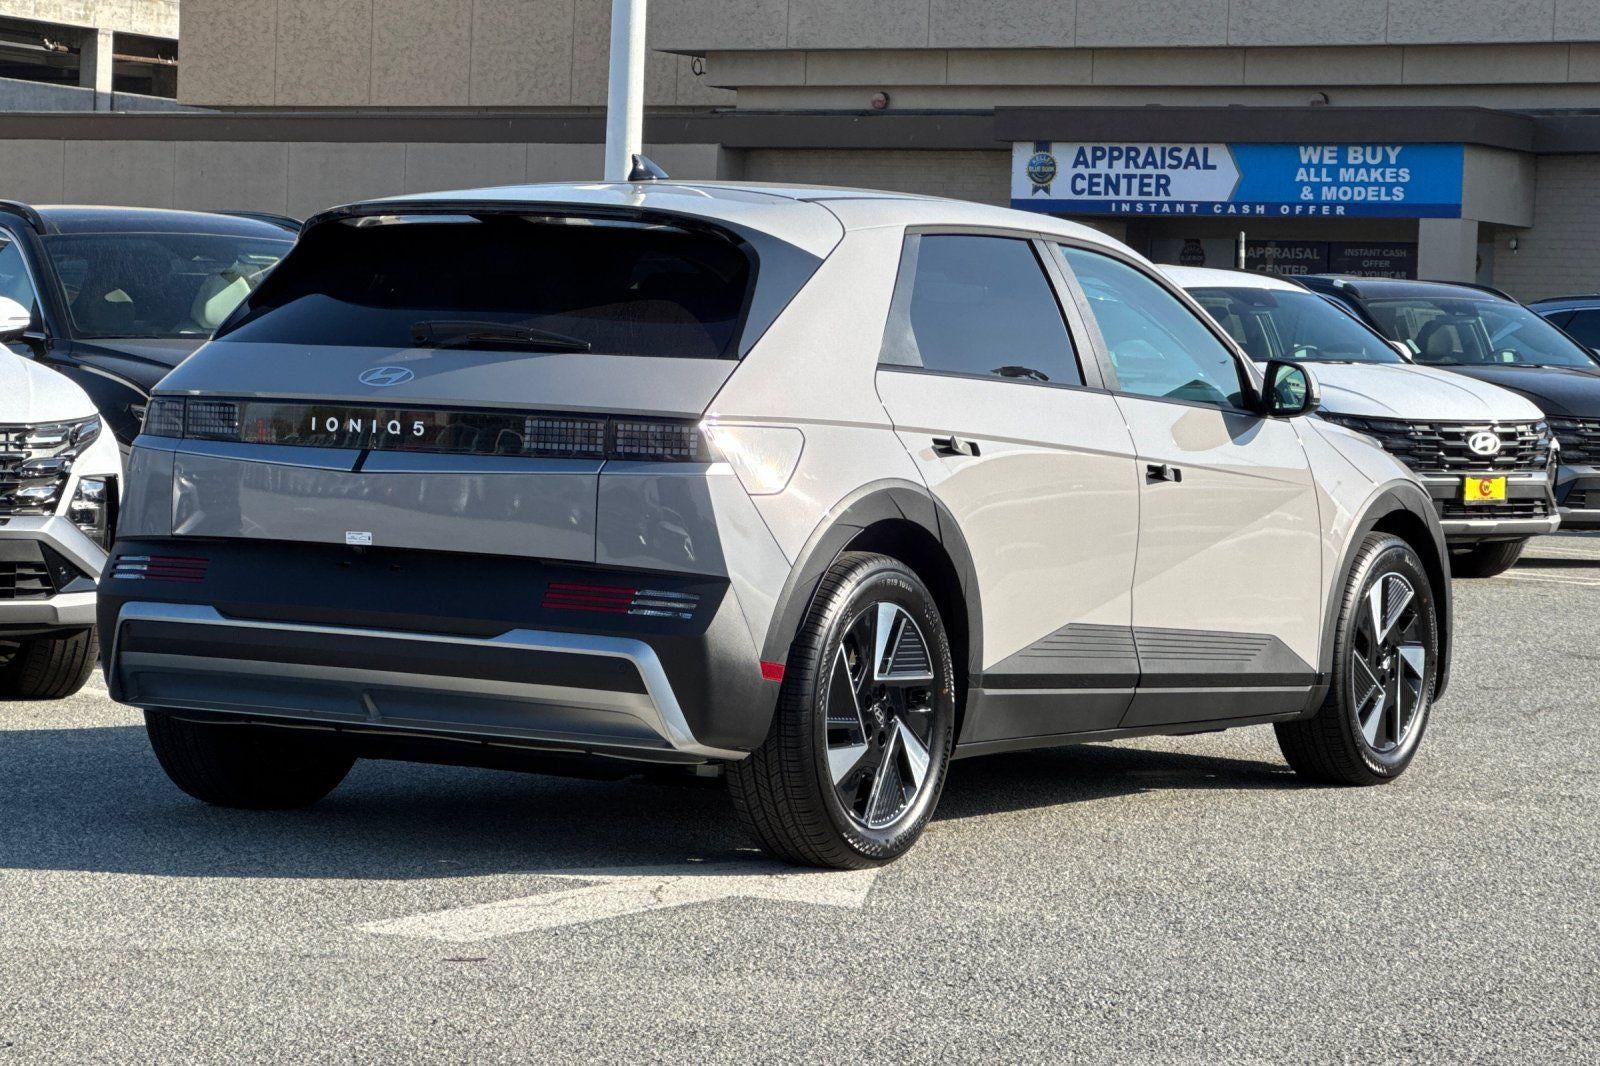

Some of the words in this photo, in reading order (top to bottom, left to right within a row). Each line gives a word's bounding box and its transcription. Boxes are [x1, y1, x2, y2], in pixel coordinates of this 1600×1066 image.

[1072, 146, 1217, 170] APPRAISAL
[1300, 146, 1337, 165] WE
[1347, 146, 1402, 165] BUY
[1295, 168, 1332, 182] ALL
[1339, 168, 1410, 182] MAKES
[1071, 173, 1171, 197] CENTER
[1300, 186, 1314, 200] &
[1321, 186, 1405, 201] MODELS
[1111, 202, 1199, 213] INSTANT
[1213, 204, 1265, 214] CASH
[1280, 206, 1345, 215] OFFER
[1247, 247, 1320, 260] APPRAISAL
[1345, 248, 1381, 257] INSTANT
[1383, 248, 1407, 257] CASH
[1362, 260, 1390, 268] OFFER
[311, 416, 401, 435] IONIQ
[412, 420, 425, 436] 5
